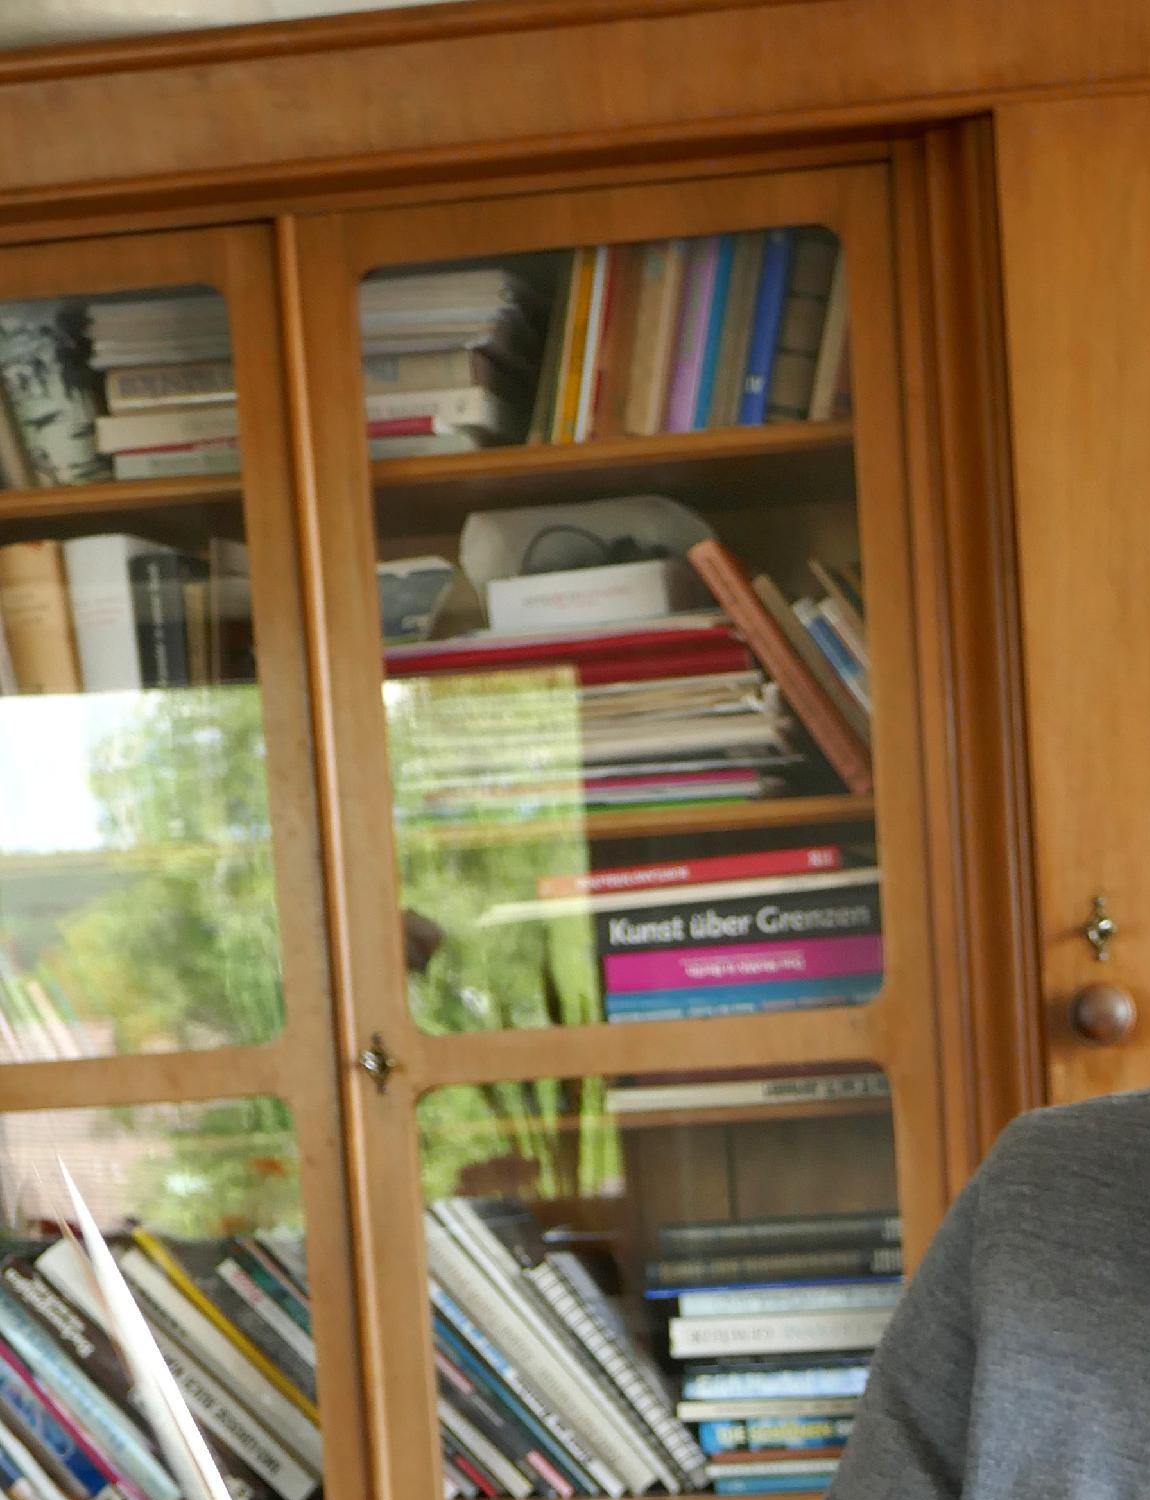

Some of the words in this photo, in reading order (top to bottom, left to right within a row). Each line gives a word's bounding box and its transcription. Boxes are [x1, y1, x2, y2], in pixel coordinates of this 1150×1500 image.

[608, 915, 684, 946] Kunst
[689, 909, 750, 939] über
[756, 905, 871, 934] Grenzen
